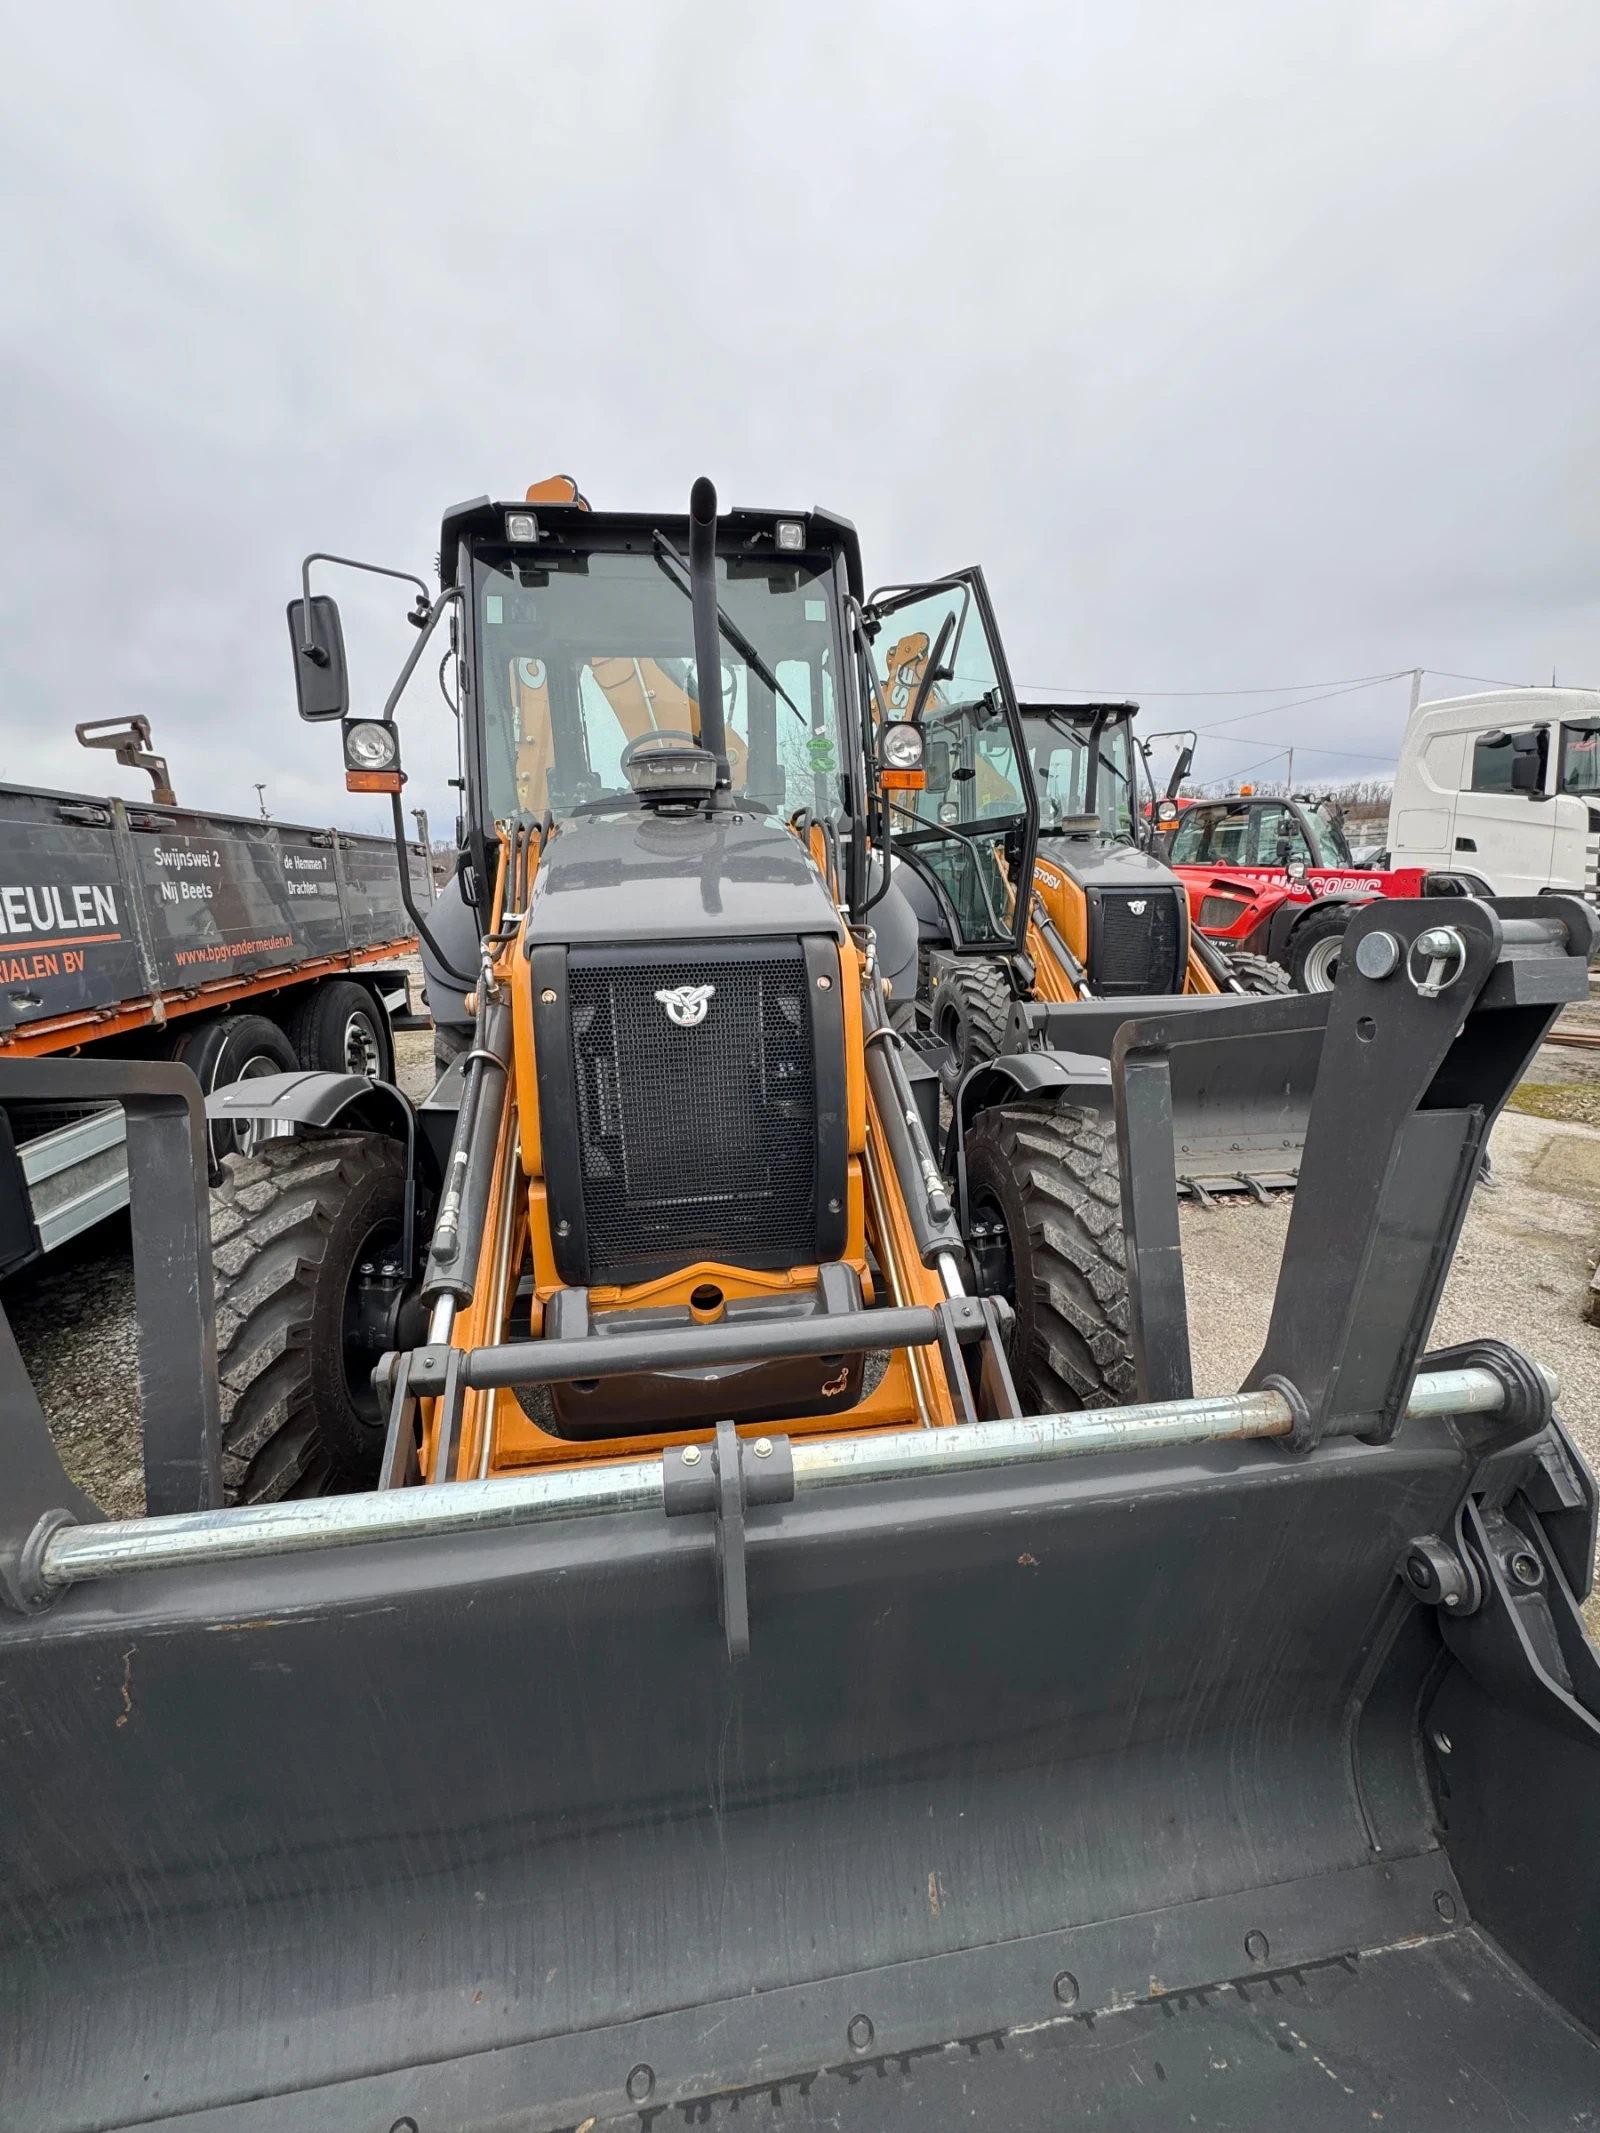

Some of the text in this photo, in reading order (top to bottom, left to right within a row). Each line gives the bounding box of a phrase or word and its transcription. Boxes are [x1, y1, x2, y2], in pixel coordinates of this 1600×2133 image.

[888, 664, 915, 721] ASE
[153, 847, 221, 871] Swijnswei 2
[284, 854, 293, 869] de
[1033, 866, 1061, 890] 570SV
[161, 881, 213, 904] Nij Beets
[0, 885, 119, 934] EULEN
[175, 932, 294, 966] www.bpgvandermeulen.nl
[62, 950, 84, 974] BV
